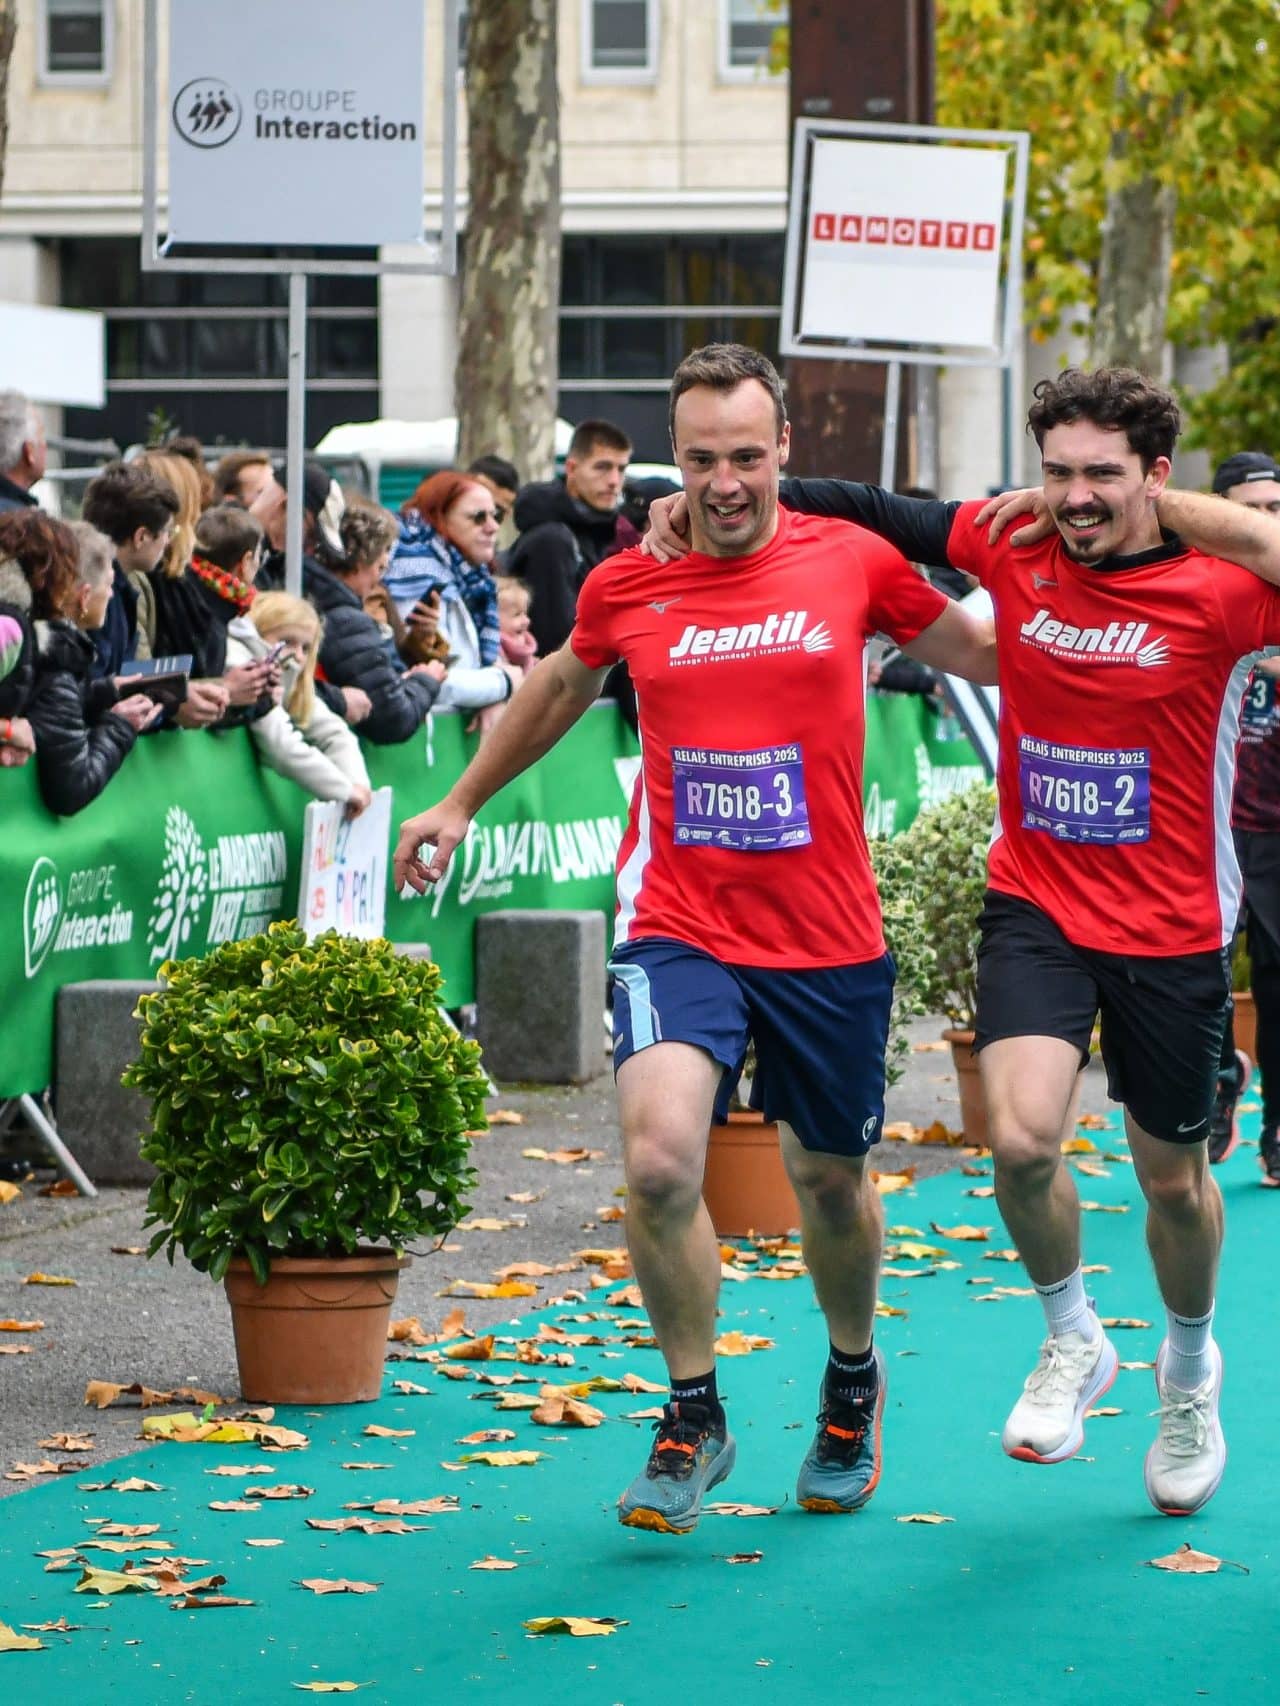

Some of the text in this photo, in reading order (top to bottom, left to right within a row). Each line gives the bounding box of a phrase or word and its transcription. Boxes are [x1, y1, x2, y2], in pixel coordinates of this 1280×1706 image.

[254, 89, 356, 112] GROUPE
[256, 114, 417, 141] Interaction
[814, 214, 995, 250] LAMOTTE
[669, 610, 808, 658] Jeantil
[759, 644, 801, 656] transport
[1020, 609, 1149, 654] Jeantil
[674, 747, 798, 767] RELAIS ENTREPRISES 2025
[1021, 737, 1145, 765] RELAIS ENTREPRISES 2025
[686, 772, 793, 821] R7618-3
[1029, 771, 1135, 816] R7618-2
[218, 830, 288, 889] MARATHON
[53, 900, 134, 953] Interaction
